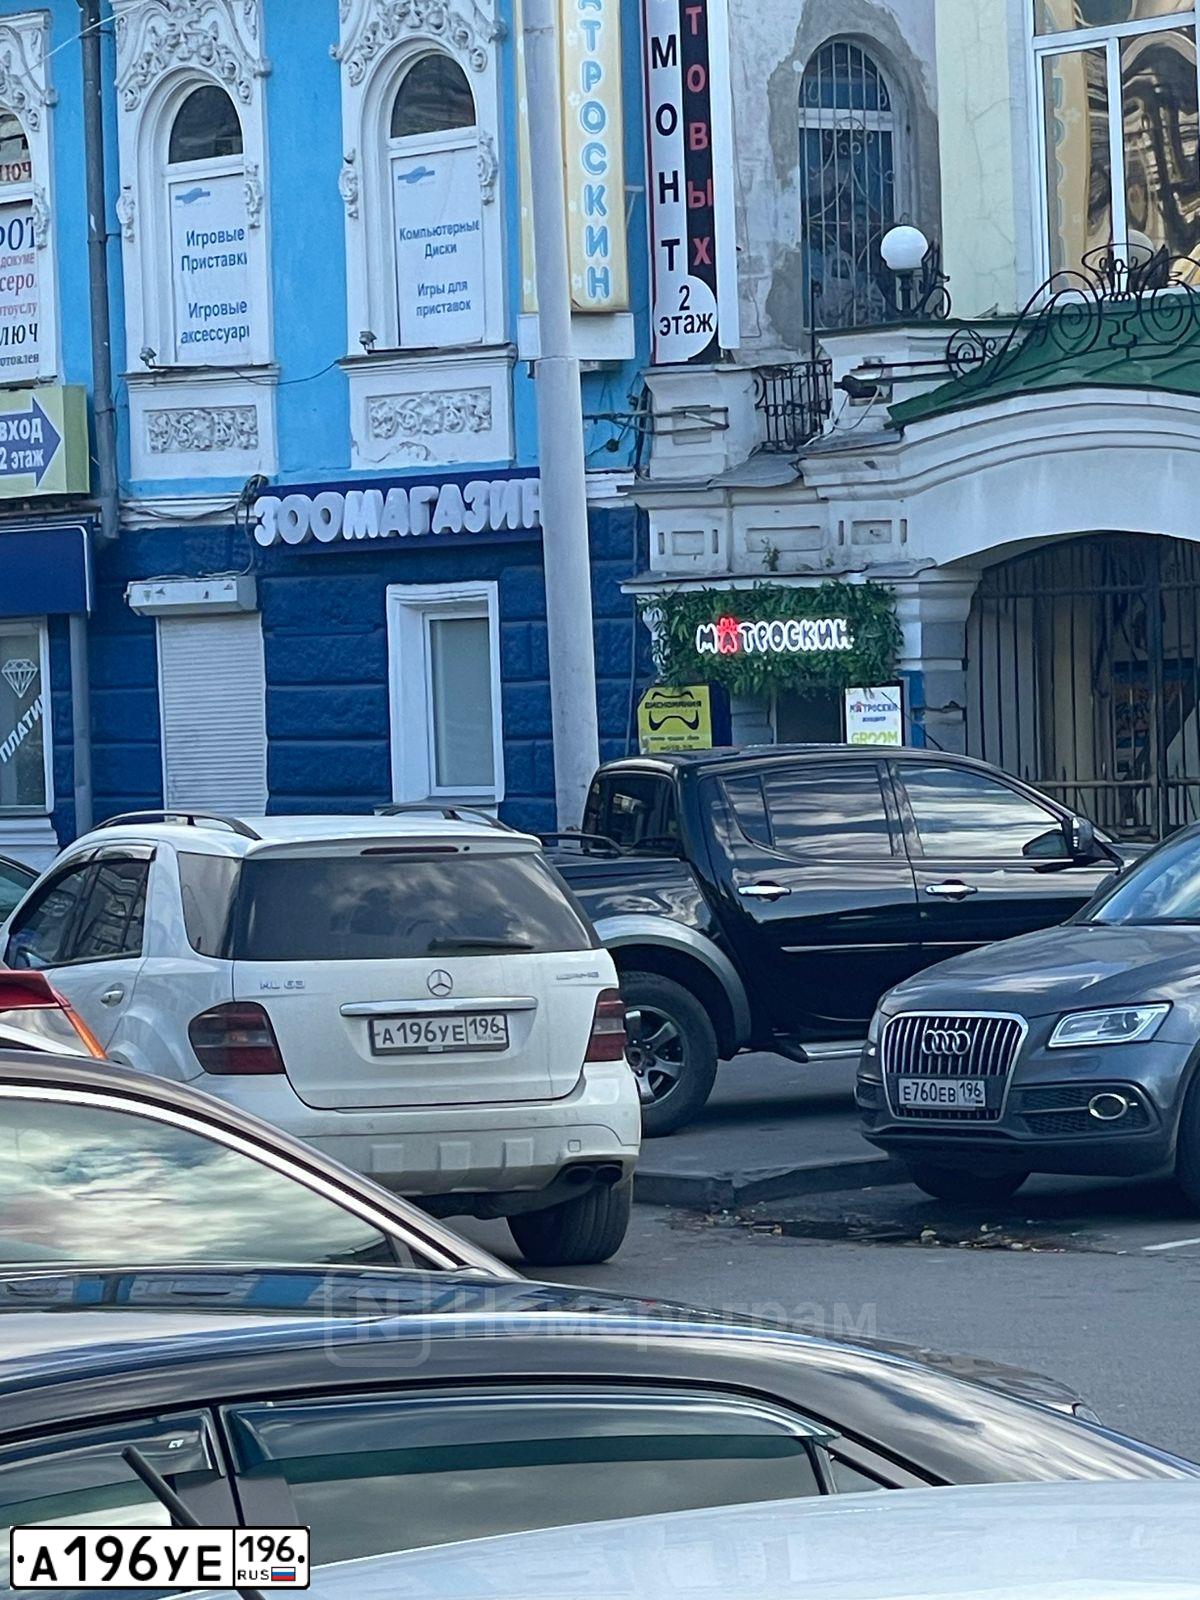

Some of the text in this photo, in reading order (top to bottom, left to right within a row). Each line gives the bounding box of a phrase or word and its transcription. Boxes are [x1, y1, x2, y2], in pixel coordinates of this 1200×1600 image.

[685, 6, 714, 266] ТОВЫХ
[651, 34, 681, 271] МОНТ
[0, 161, 32, 182] ЮЧ
[186, 228, 245, 249] Игровые
[424, 243, 457, 259] Диски
[417, 280, 468, 298] Игры для
[678, 285, 690, 311] 2
[188, 300, 247, 321] Игровые
[416, 300, 471, 318] приставок
[659, 312, 714, 336] этаж
[0, 446, 44, 470] 2 этаж
[254, 477, 541, 547] ЗООМАГАЗИН
[0, 693, 44, 763] ПЛАТИ
[468, 1017, 500, 1035] 196
[959, 1082, 981, 1097] 196
